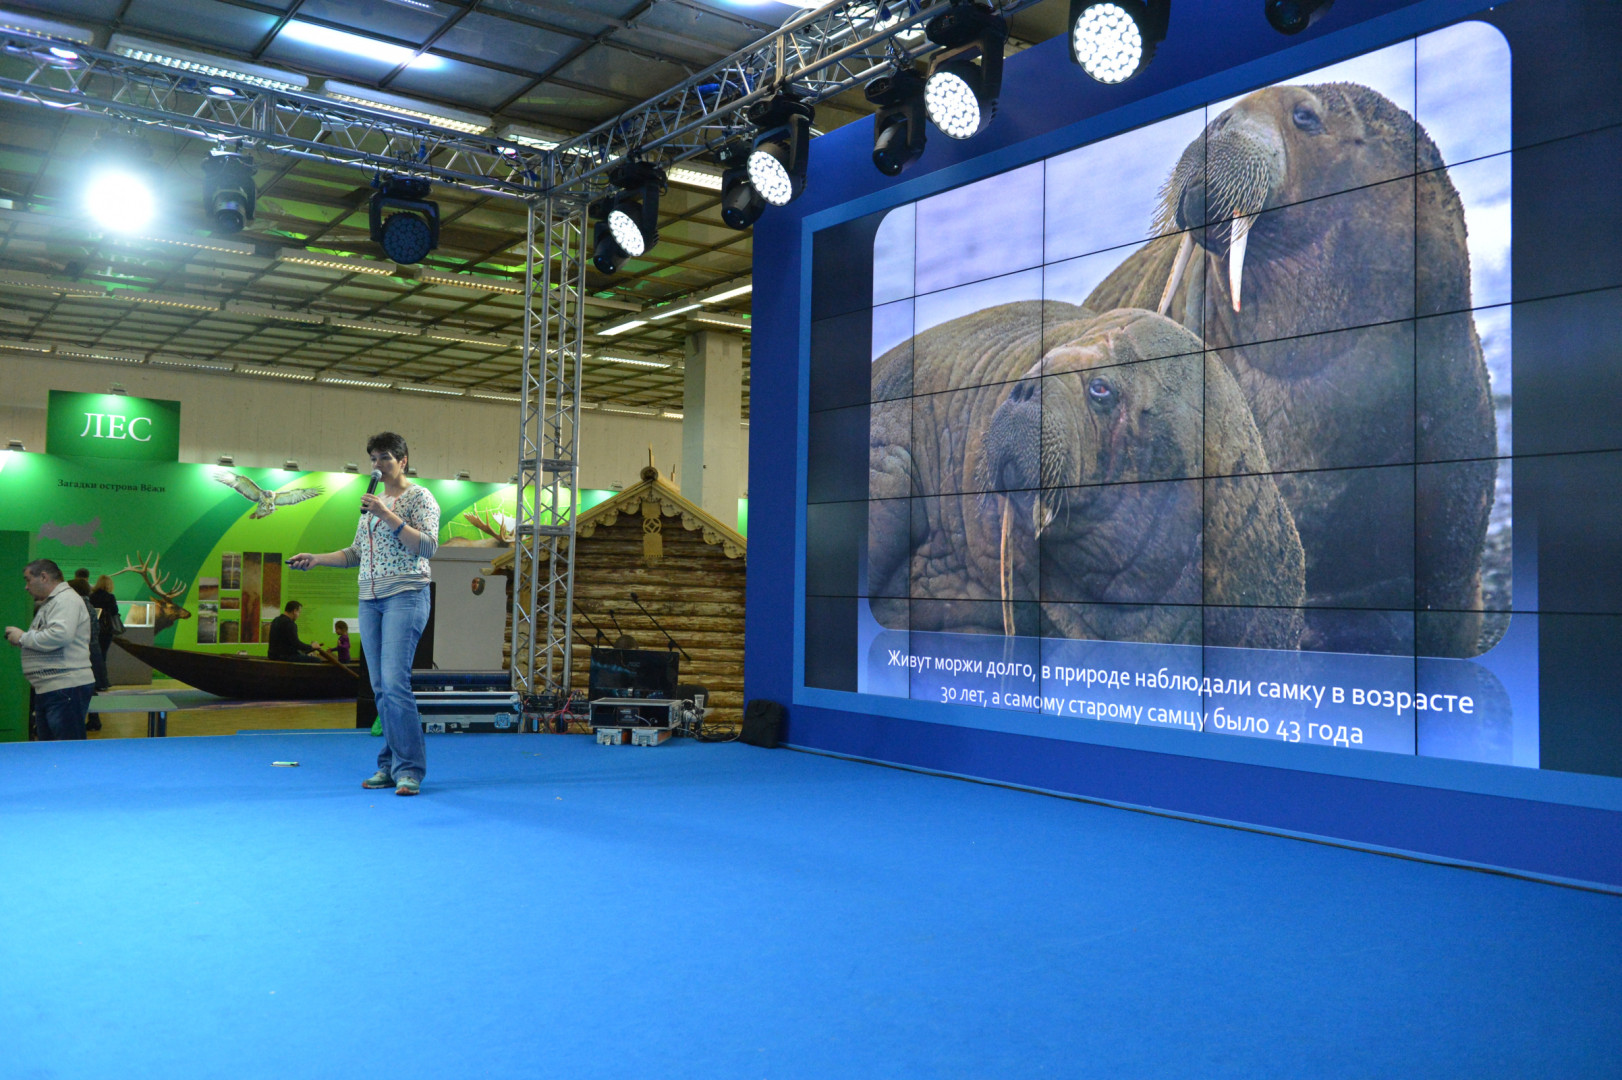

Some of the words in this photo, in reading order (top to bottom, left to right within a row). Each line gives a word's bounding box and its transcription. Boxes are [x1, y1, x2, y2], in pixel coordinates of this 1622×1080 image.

[80, 412, 152, 442] ЛЕС
[57, 479, 97, 490] Загадки
[99, 481, 138, 493] острова
[887, 650, 932, 673] Живут
[934, 658, 983, 677] моржи
[986, 662, 1037, 682] долго,
[1042, 666, 1051, 680] в
[1055, 667, 1130, 688] природе
[1135, 668, 1252, 696] наблюдали
[1257, 681, 1326, 708] самку
[1332, 686, 1345, 703] в
[1352, 688, 1474, 715] возрасте
[940, 686, 957, 703] 30
[960, 687, 987, 707] лет,
[991, 690, 1001, 705] а
[1003, 694, 1065, 716] самому
[1068, 696, 1143, 725] старому
[1147, 707, 1209, 732] самцу
[1213, 707, 1269, 734] было
[1276, 720, 1301, 743] 43
[1308, 723, 1363, 748] года
